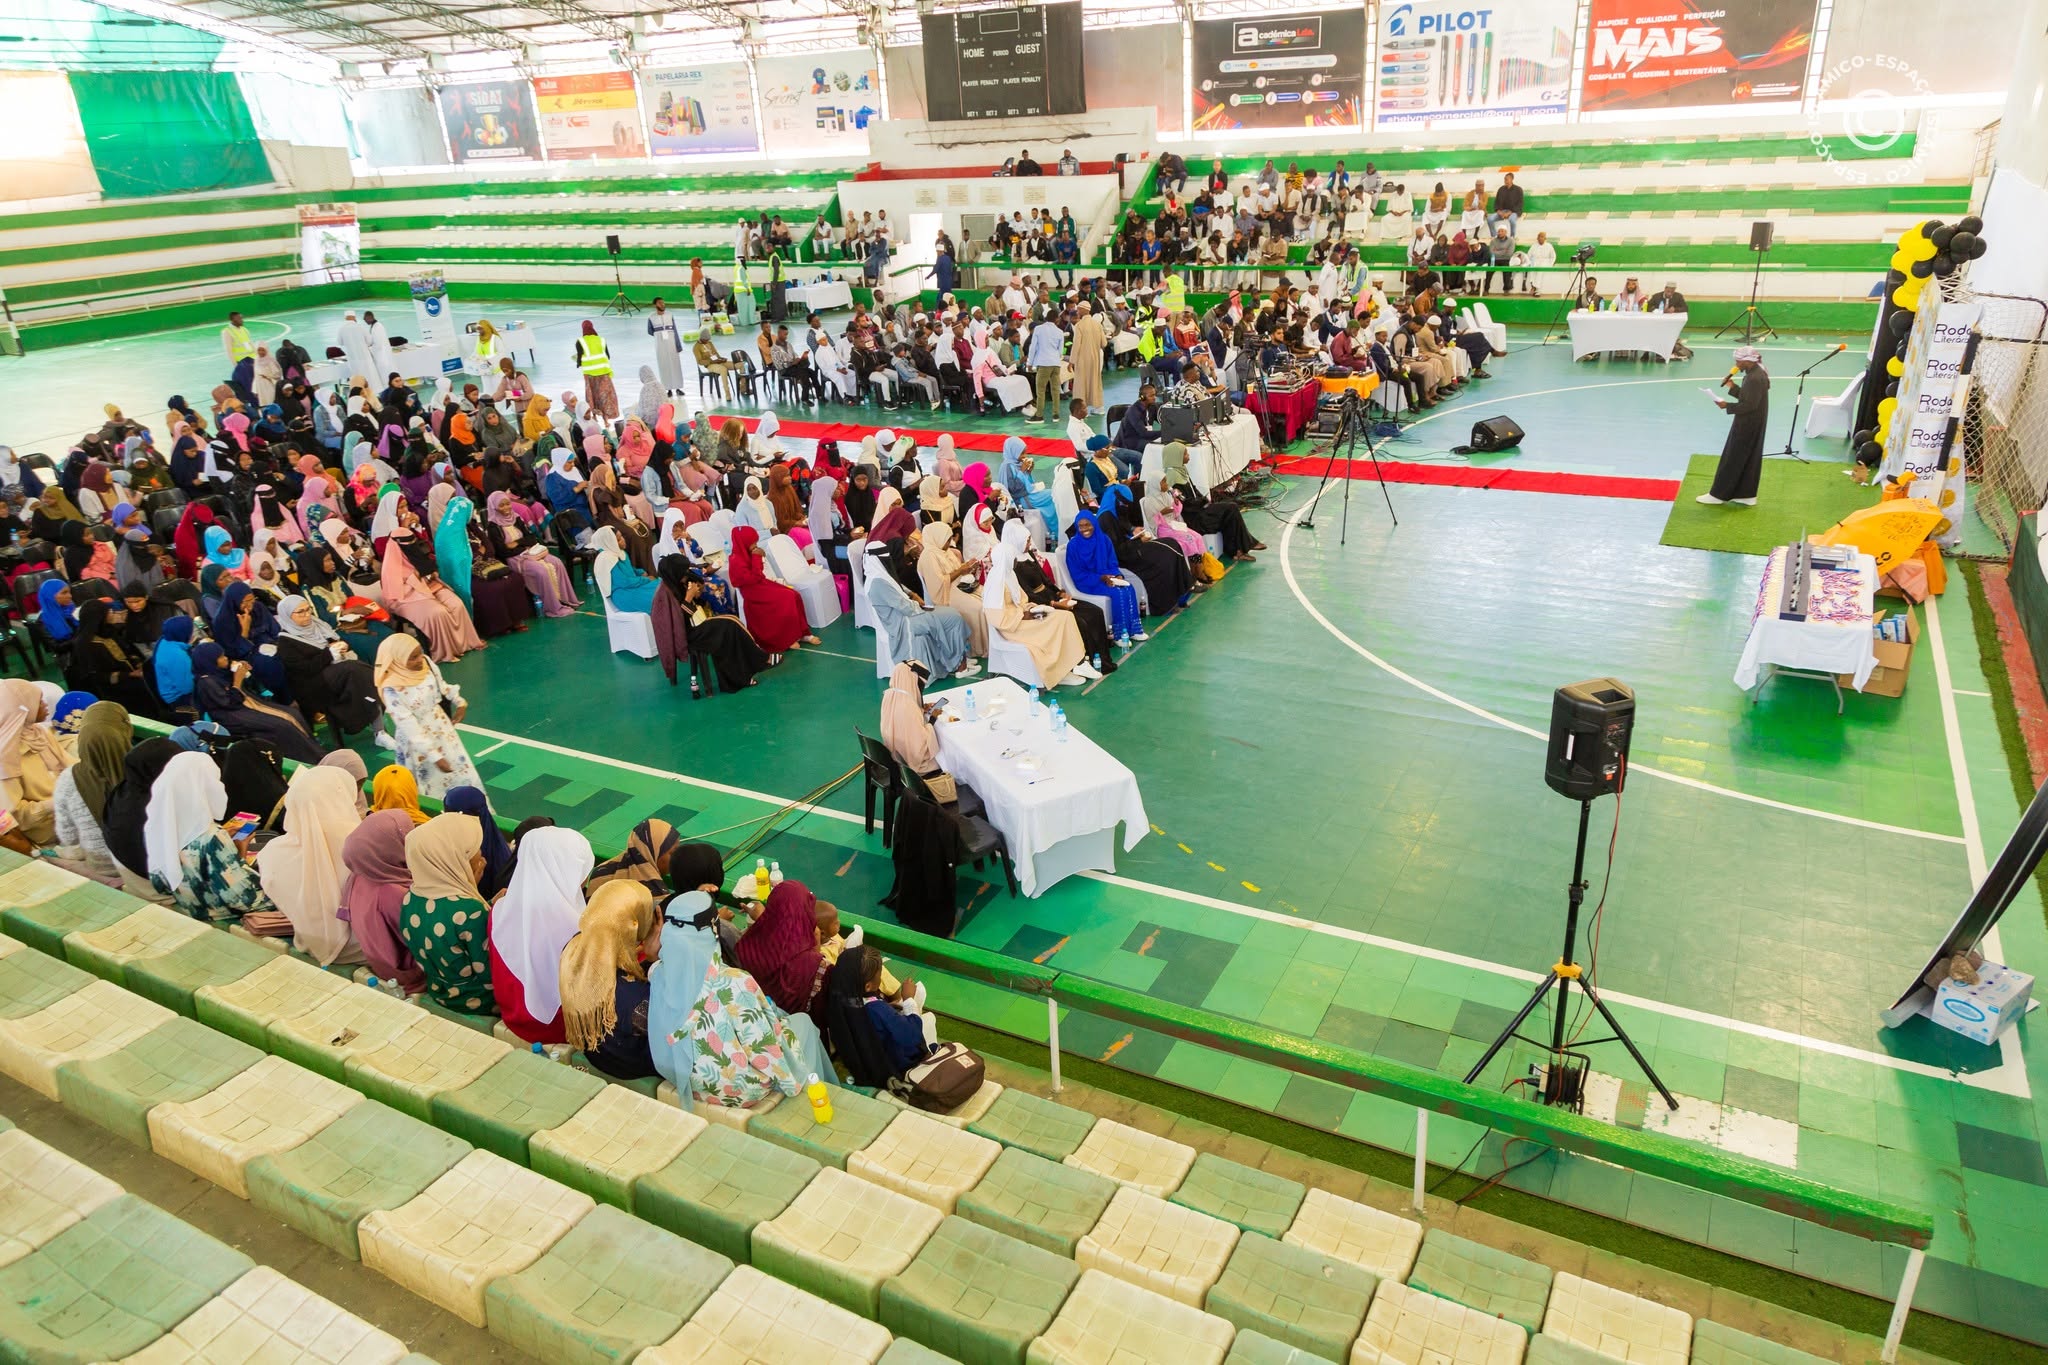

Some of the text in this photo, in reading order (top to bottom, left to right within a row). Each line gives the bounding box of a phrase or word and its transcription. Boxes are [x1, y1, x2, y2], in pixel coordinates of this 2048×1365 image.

[1418, 9, 1493, 35] PILOT
[1635, 14, 1678, 25] QUALIDADE
[963, 48, 984, 58] HOME
[1015, 44, 1040, 54] GUEST
[1593, 27, 1723, 72] MAIS
[655, 70, 702, 81] PAPELARIA REX
[1540, 89, 1569, 102] G-2
[1919, 394, 1953, 407] Roda
